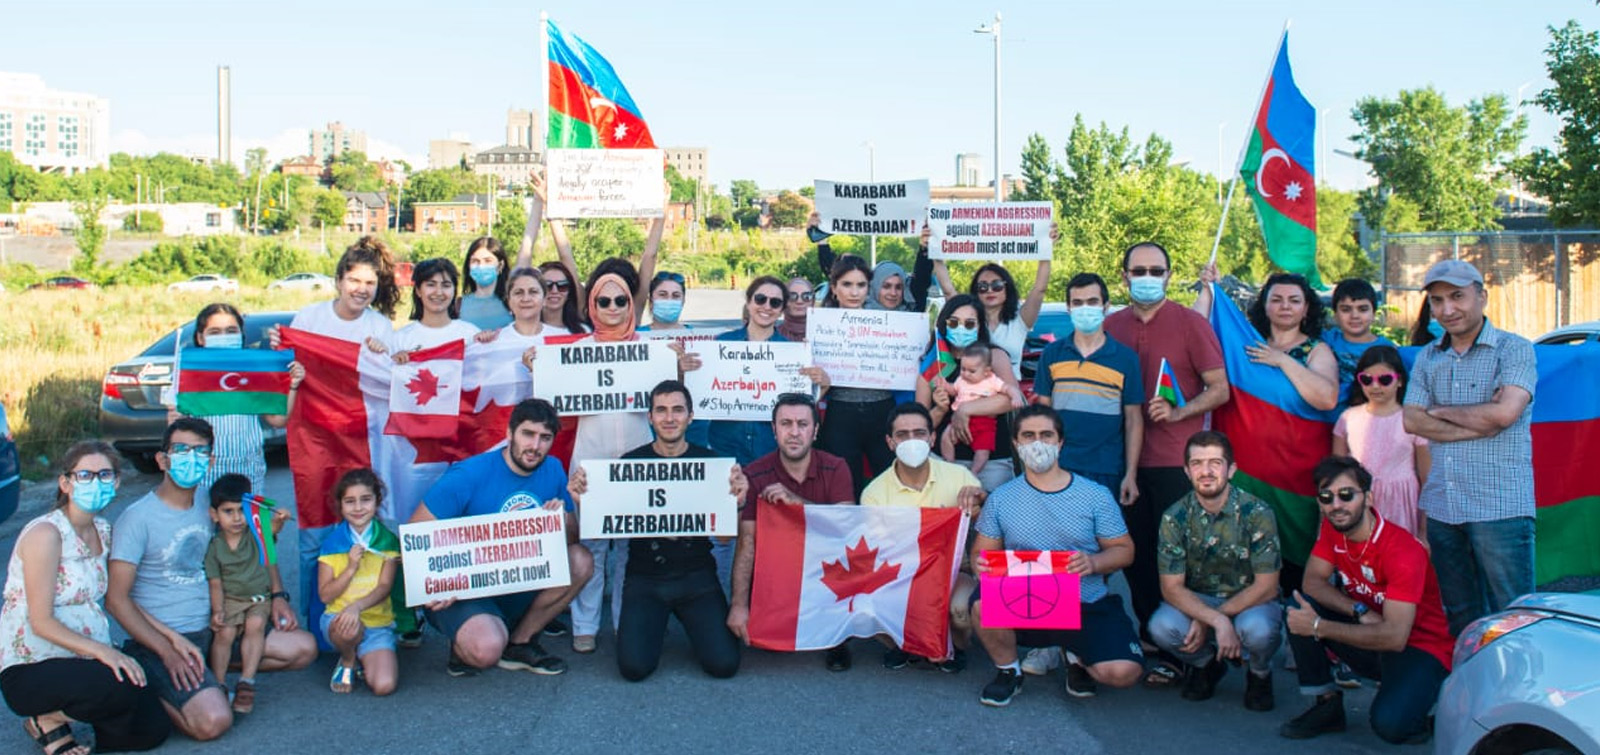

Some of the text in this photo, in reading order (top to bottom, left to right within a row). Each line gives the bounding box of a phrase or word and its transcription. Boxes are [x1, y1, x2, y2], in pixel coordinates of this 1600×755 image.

[834, 184, 906, 199] KARABAKH
[864, 203, 878, 216] IS
[930, 206, 1051, 221] Stop ARMENIAN AGGRESSION
[832, 218, 908, 234] AZERBAIJAN
[946, 222, 1034, 236] against AZERBAIJAN!
[941, 239, 1039, 253] Canada must act now!
[840, 311, 889, 325] Armenia!
[560, 344, 649, 365] KARABAKH
[719, 343, 775, 361] Karabakh
[597, 369, 614, 387] IS
[743, 365, 751, 375] is
[711, 377, 776, 400] Azerbaijan
[609, 462, 705, 482] KARABAKH
[502, 495, 533, 513] ORONTO
[648, 488, 667, 508] IS
[602, 513, 706, 534] AZERBAIJAN
[403, 514, 562, 552] Stop ARMENIAN AGGRESSION
[428, 539, 543, 573] against AZERBAIJAN!
[425, 561, 551, 595] Canada must act now!
